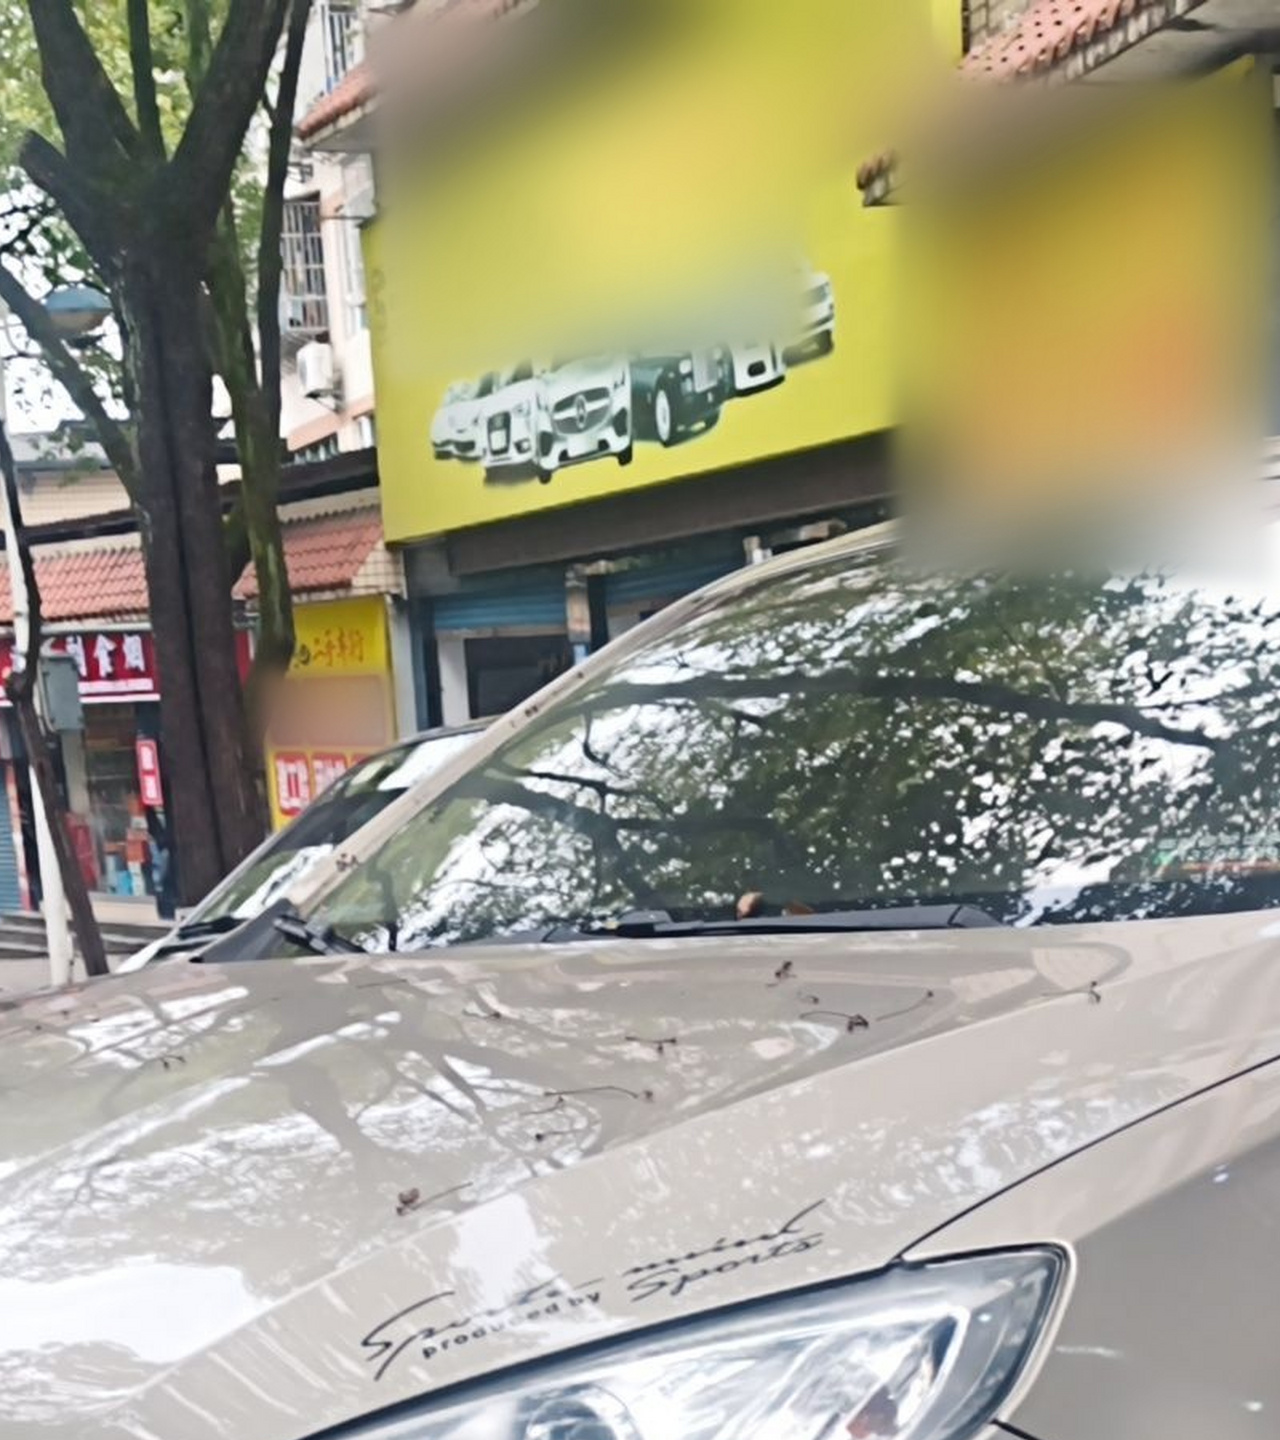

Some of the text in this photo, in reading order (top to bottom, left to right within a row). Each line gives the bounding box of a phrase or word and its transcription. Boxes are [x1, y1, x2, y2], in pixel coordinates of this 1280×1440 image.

[422, 1232, 824, 1361] produced by Sports
